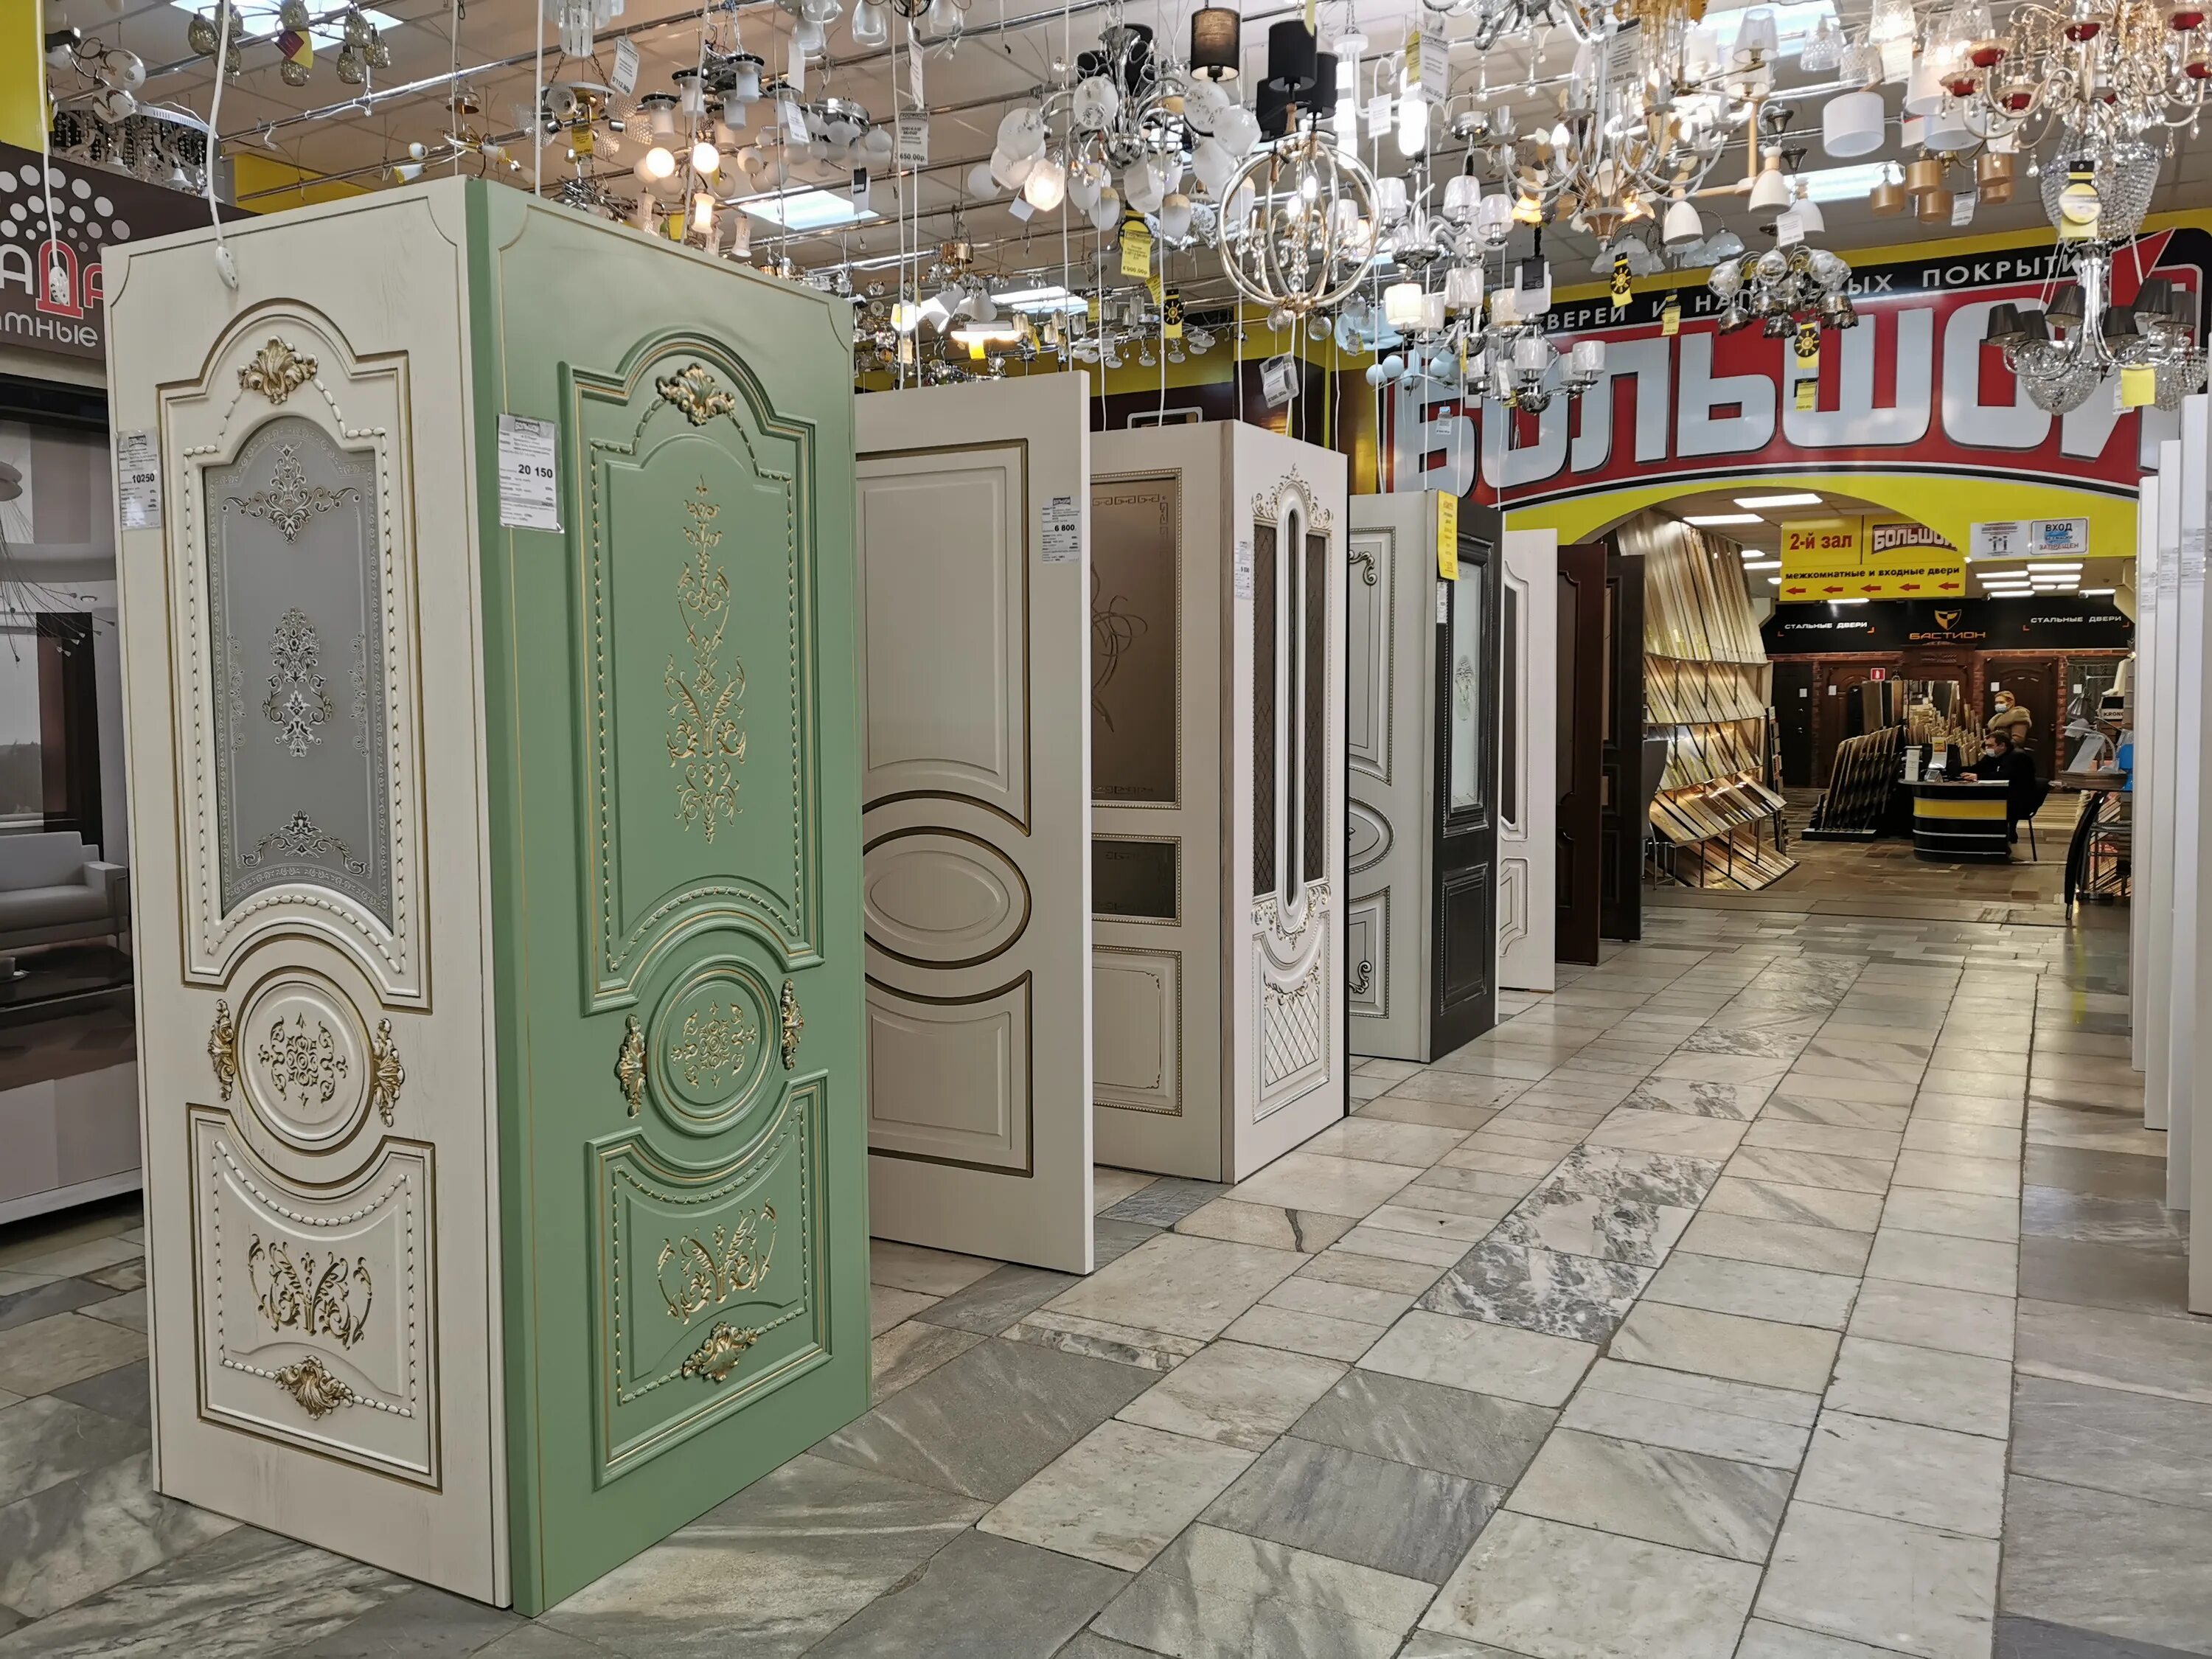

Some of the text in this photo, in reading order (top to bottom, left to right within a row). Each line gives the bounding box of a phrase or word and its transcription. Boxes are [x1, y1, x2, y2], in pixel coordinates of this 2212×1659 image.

[1538, 305, 1625, 330] ВЕРЕЙ
[1923, 254, 2084, 288] ПОКРЫТИ
[0, 310, 98, 347] тные
[518, 464, 553, 478] 20 150
[2045, 523, 2073, 532] ВХОД
[1790, 532, 1853, 550] 2-й зал
[1785, 570, 1865, 580] межкомнатные
[1879, 568, 1925, 577] входные
[1927, 567, 1960, 577] двери
[1909, 632, 1986, 640] БАСТИОН
